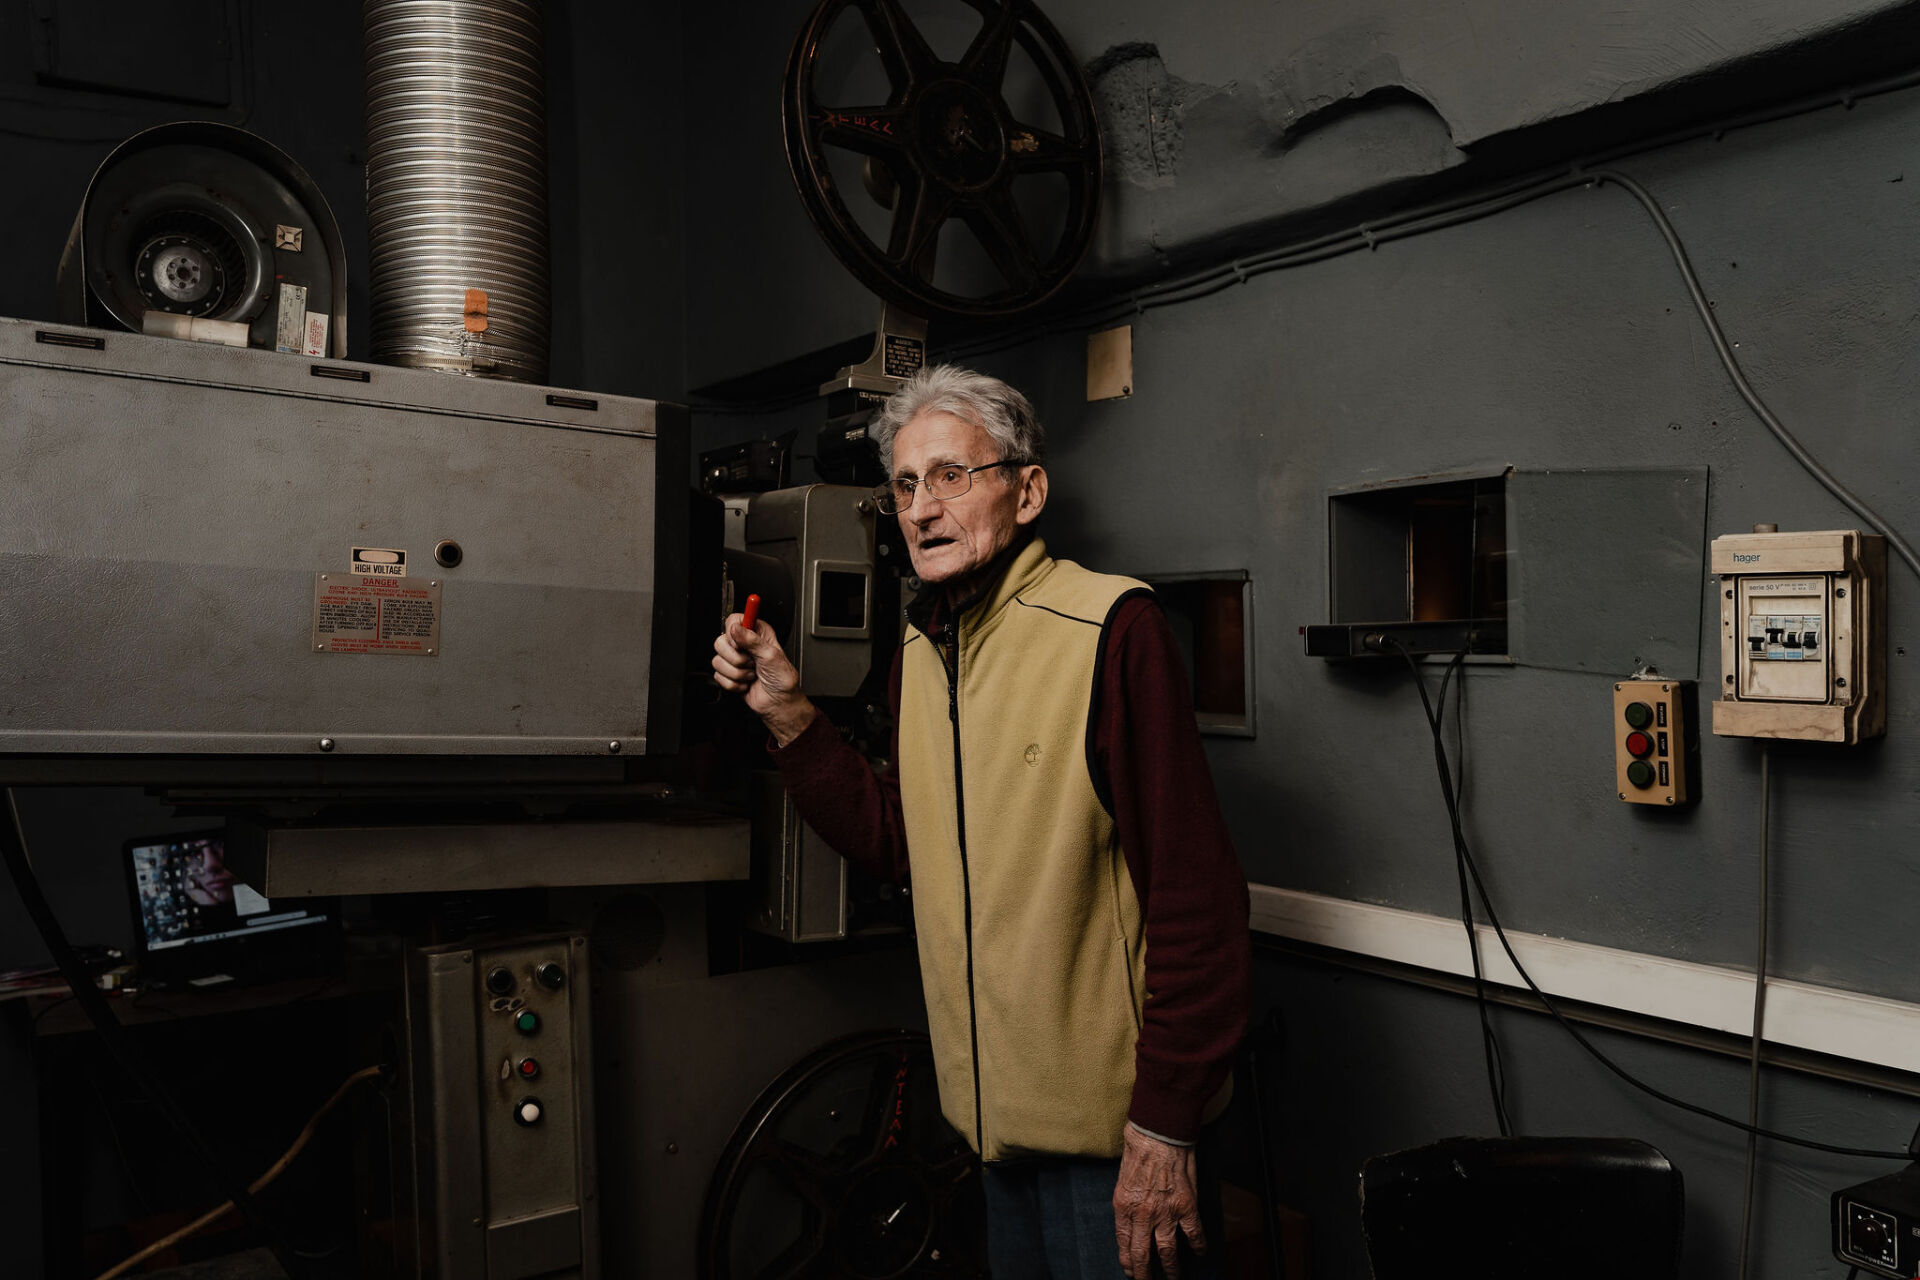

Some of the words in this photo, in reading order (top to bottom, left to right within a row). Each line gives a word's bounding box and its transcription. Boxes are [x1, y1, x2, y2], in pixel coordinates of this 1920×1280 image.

[1733, 552, 1760, 563] hager
[355, 564, 371, 573] HIGH
[373, 566, 402, 575] VOLTAGE
[362, 577, 398, 586] DANGER
[1882, 1254, 1894, 1263] MAX
